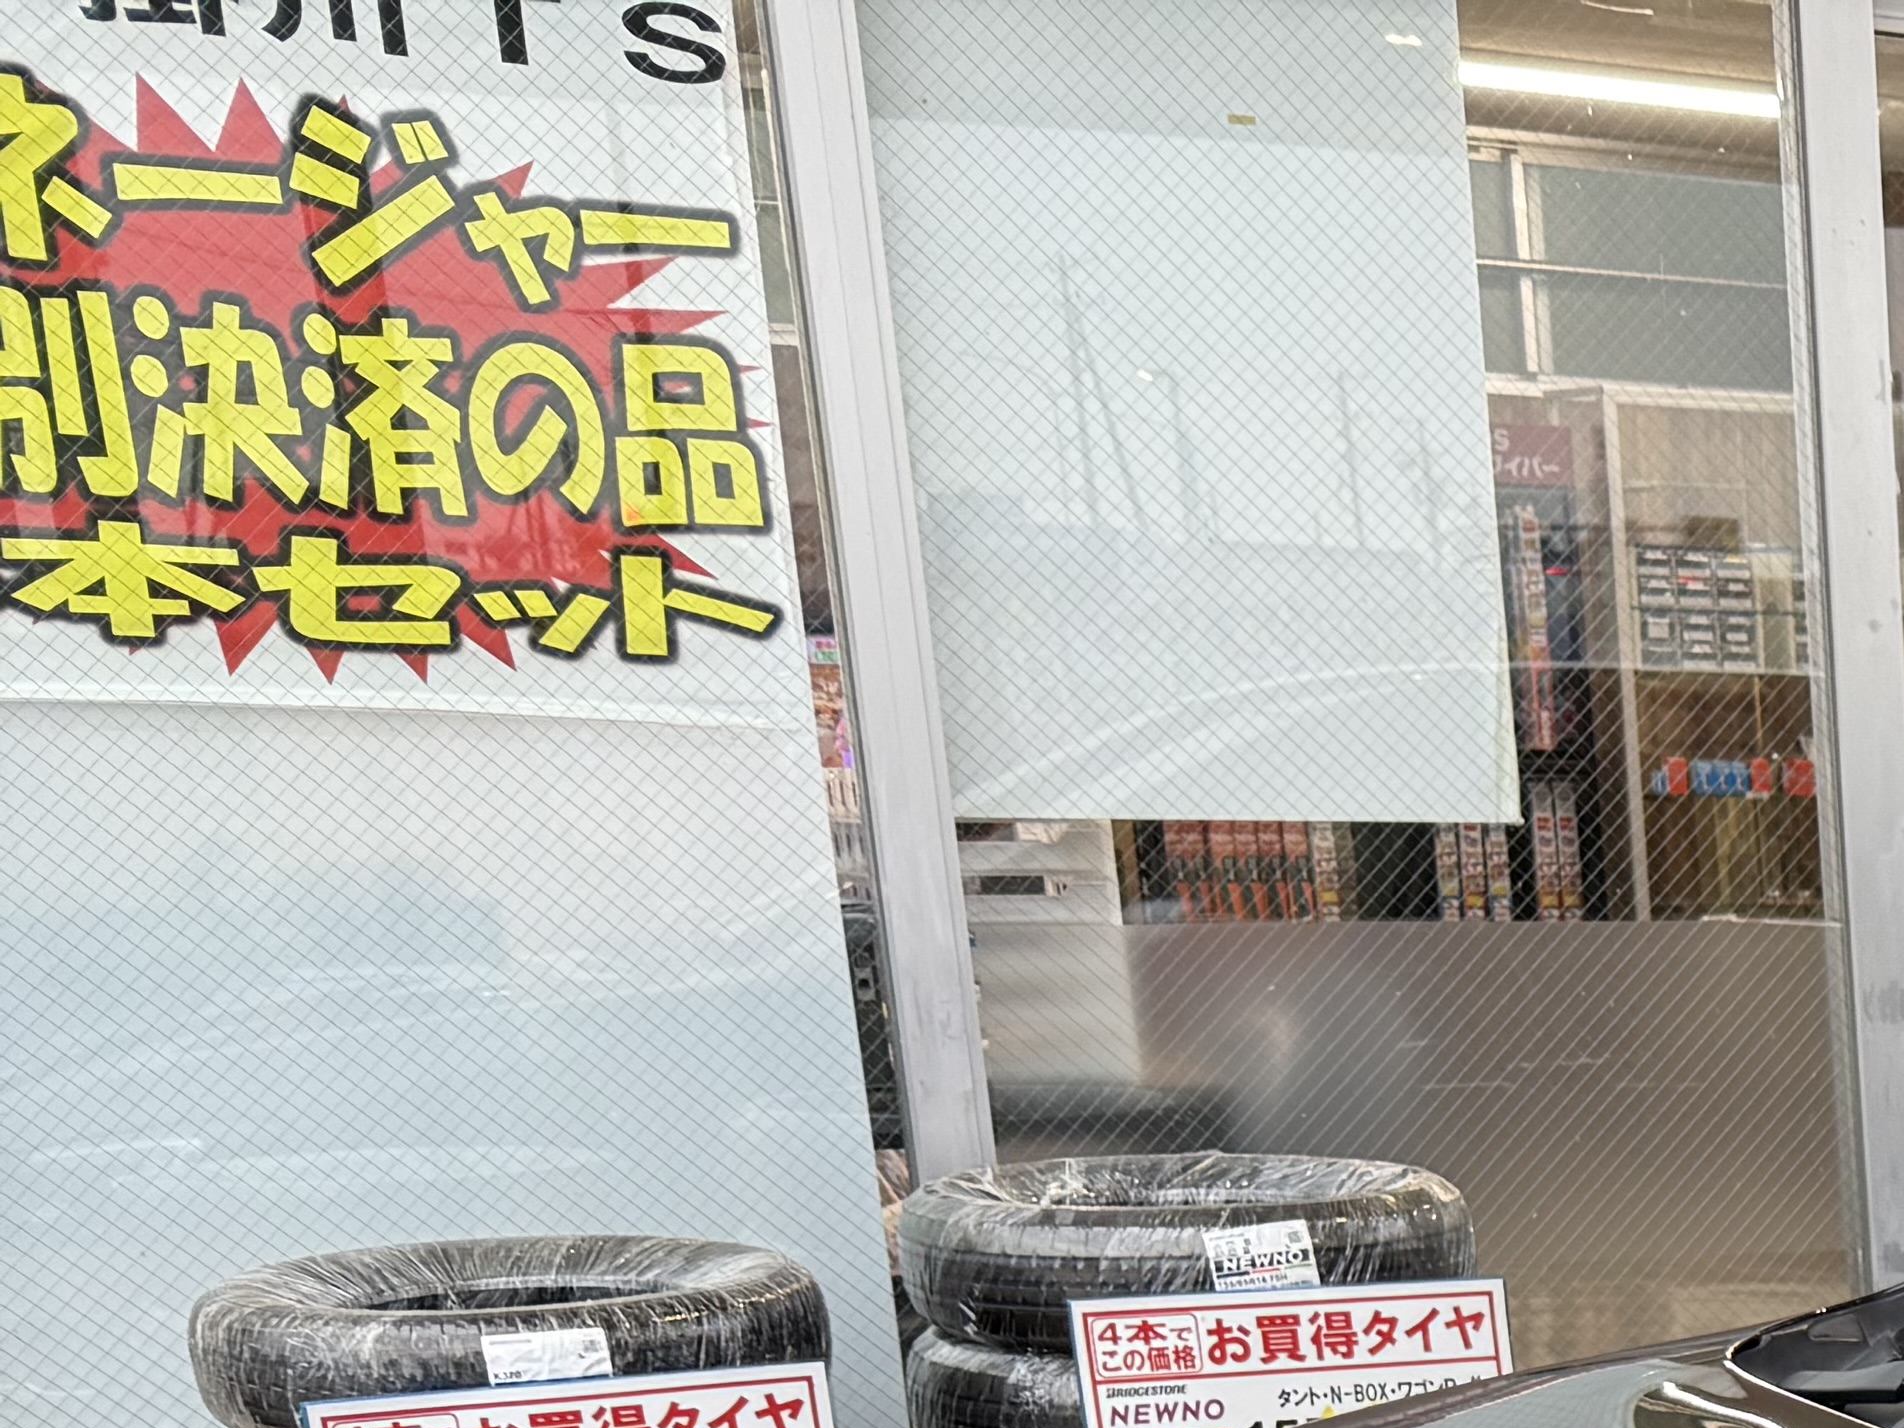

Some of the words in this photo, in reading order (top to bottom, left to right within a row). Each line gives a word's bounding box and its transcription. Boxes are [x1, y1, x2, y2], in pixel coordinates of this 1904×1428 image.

[1224, 1249, 1303, 1272] NEWNO
[1098, 1320, 1192, 1346] 4本で
[1207, 1305, 1486, 1365] お買得タイヤ
[1101, 1345, 1197, 1373] この価格
[1106, 1384, 1187, 1399] BRIDGESTONE
[1110, 1399, 1225, 1427] NEWNO
